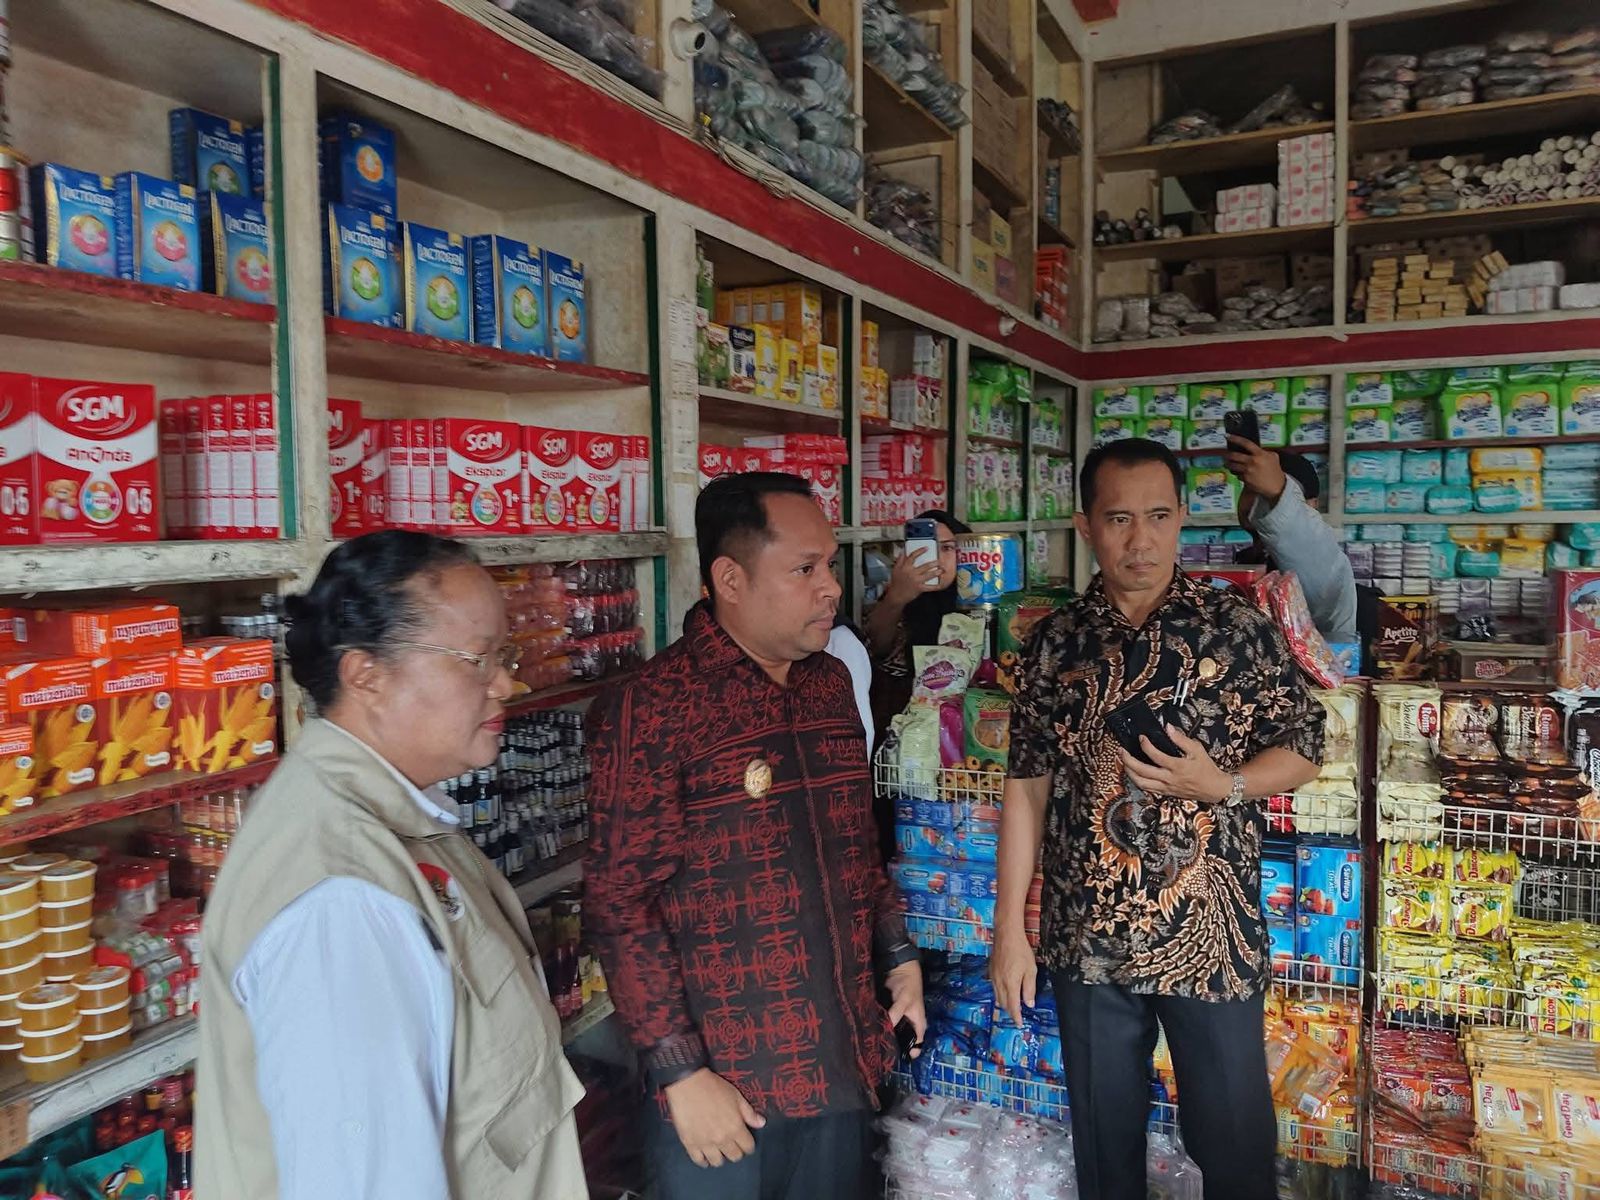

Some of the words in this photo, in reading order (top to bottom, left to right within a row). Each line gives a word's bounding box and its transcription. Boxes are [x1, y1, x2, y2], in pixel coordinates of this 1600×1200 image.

[417, 243, 464, 267] LACTOGEN
[67, 394, 124, 422] SGM
[466, 431, 503, 451] SGM
[542, 437, 567, 456] SGM
[589, 442, 613, 459] SGM
[956, 548, 1002, 572] Tango
[105, 673, 165, 693] maizenaku
[213, 666, 269, 683] maizenaku
[21, 684, 87, 705] maizenaku
[1421, 706, 1433, 733] Roma
[1468, 850, 1478, 879] Dancow
[1342, 867, 1352, 899] SariWangi
[1466, 904, 1477, 935] Dancow
[1395, 983, 1408, 1011] Dacow
